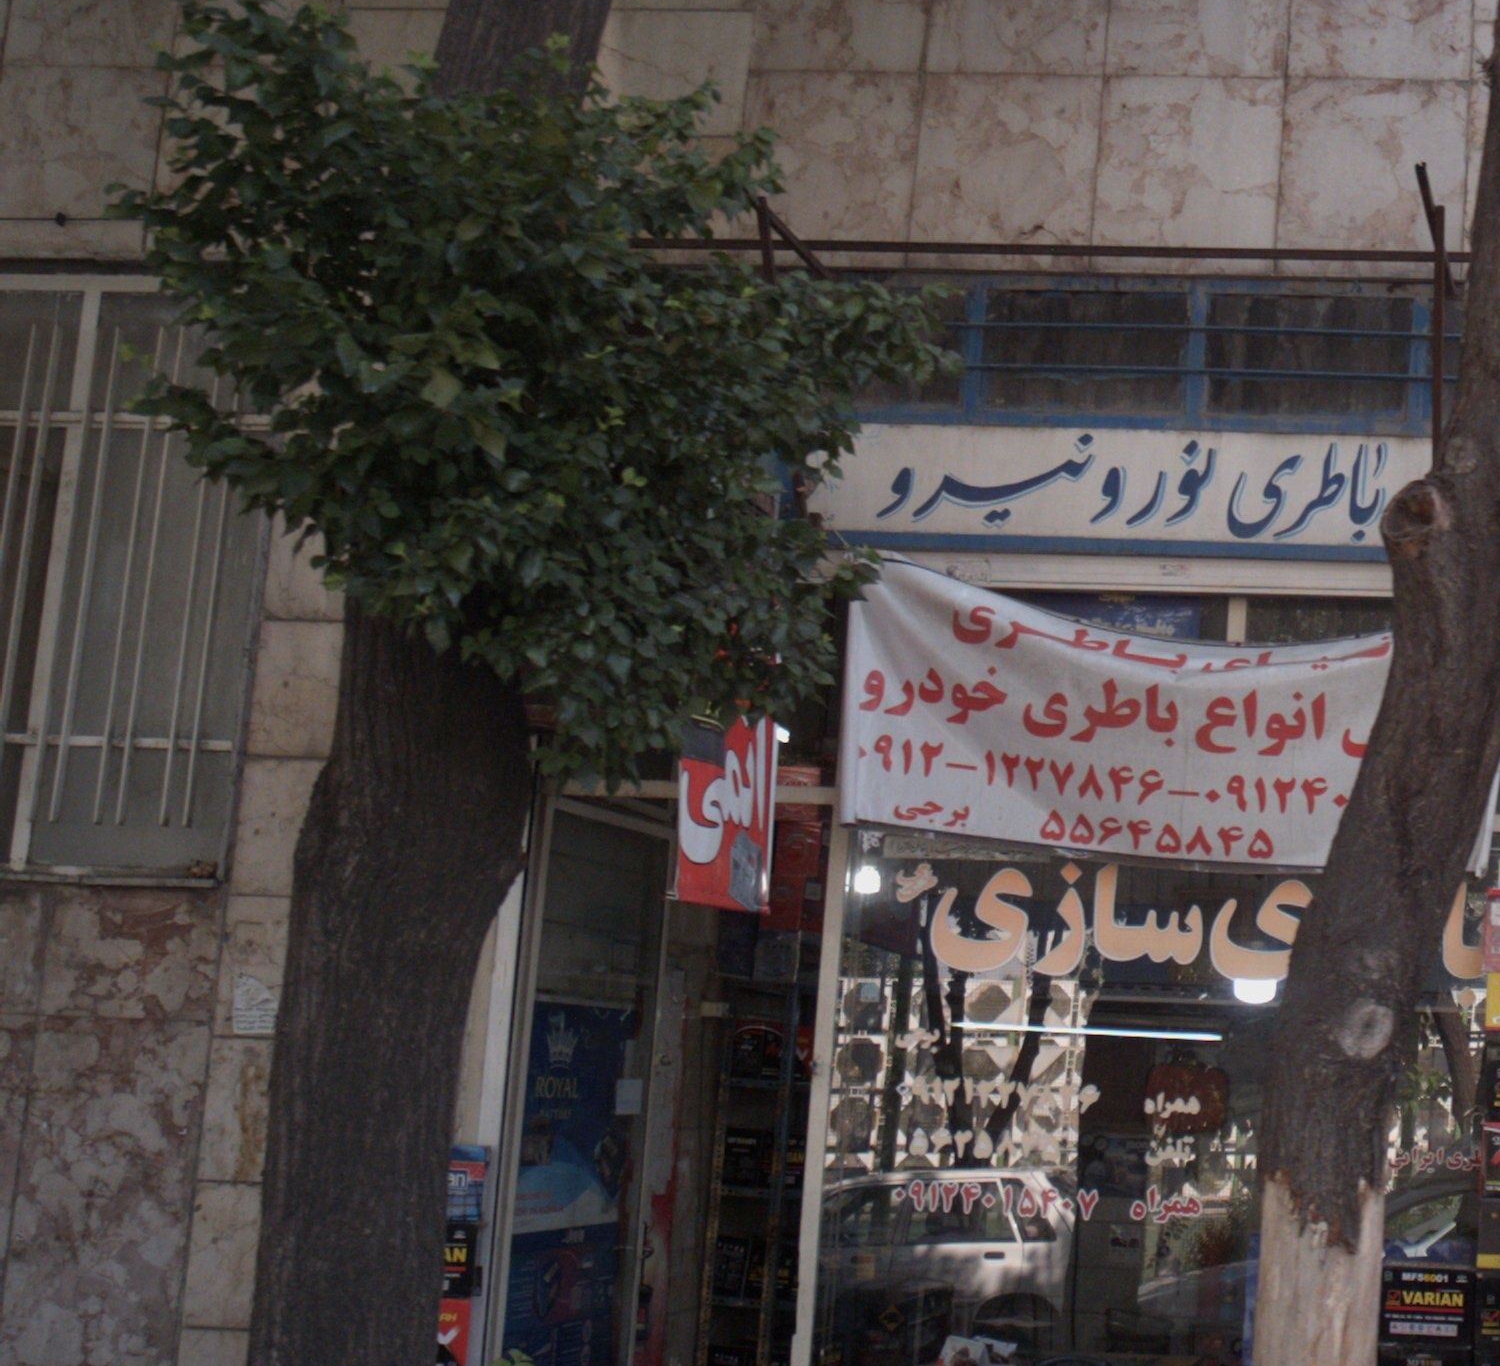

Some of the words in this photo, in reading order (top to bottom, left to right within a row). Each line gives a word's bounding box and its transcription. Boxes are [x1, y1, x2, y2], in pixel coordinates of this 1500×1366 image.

[877, 434, 1094, 529] نیرو
[1091, 466, 1126, 525] و
[1126, 440, 1216, 527] نور
[1226, 442, 1388, 541] باطری
[953, 606, 1188, 670] باطری
[859, 666, 1008, 723] خودرو
[1022, 677, 1180, 747] باطری
[1195, 688, 1327, 756] انواع
[894, 800, 971, 829] برجی
[1040, 809, 1273, 859] ۵۵۶۴۵۸۴۵
[930, 861, 1204, 976] سازی
[536, 1076, 579, 1099] ROYAL
[1143, 1092, 1201, 1118] همراه
[1145, 1135, 1196, 1167] تلفن
[894, 1180, 1099, 1221] ۰۹۱۲۴۰۱۵۴۰۷
[1129, 1184, 1201, 1224] همراه
[1402, 1290, 1465, 1307] VARIAN
